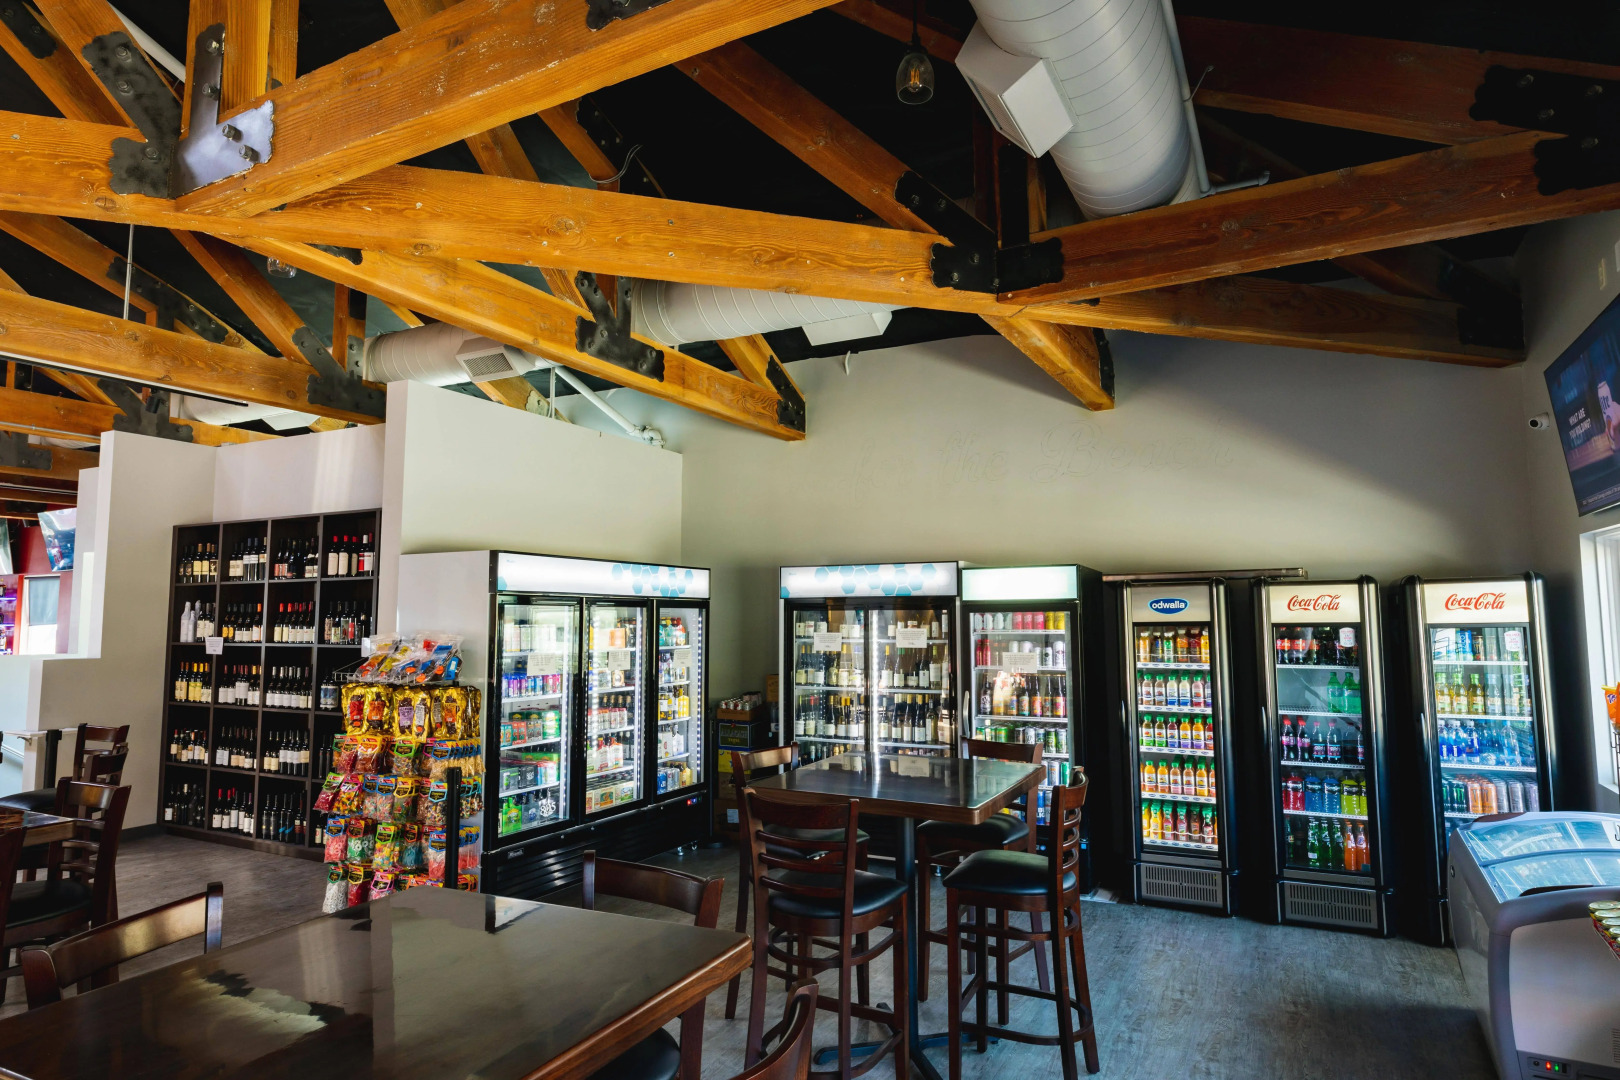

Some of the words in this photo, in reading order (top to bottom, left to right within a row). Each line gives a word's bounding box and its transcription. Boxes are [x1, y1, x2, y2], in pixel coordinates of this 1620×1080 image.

[1569, 412, 1578, 427] WHAT
[1578, 407, 1586, 420] ARE
[1575, 418, 1592, 435] HOLDING?
[1151, 599, 1186, 611] odwalla
[1287, 595, 1341, 611] Coca-Cola
[1445, 592, 1507, 610] Coca-Cola
